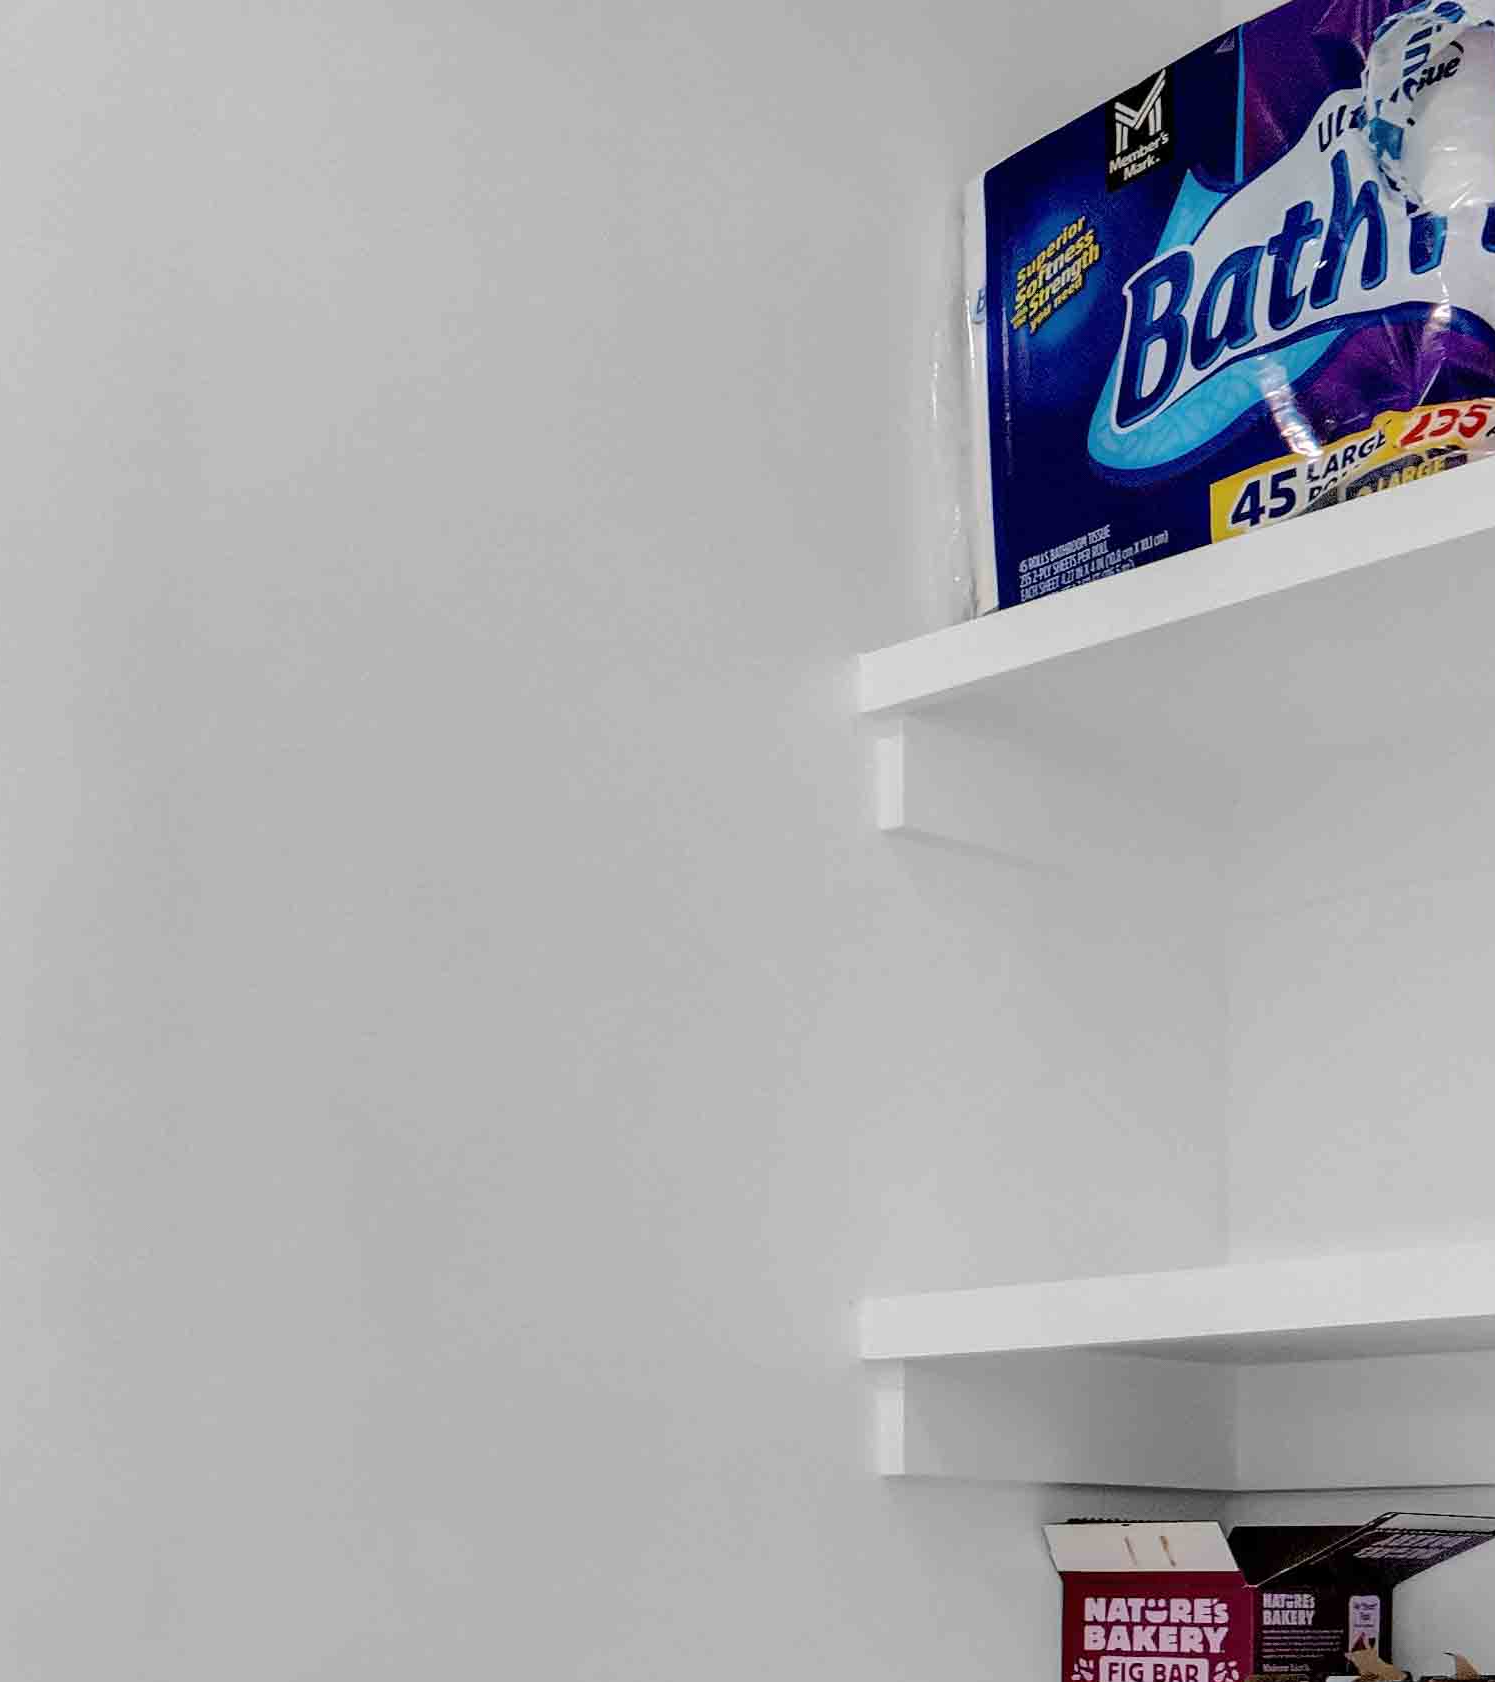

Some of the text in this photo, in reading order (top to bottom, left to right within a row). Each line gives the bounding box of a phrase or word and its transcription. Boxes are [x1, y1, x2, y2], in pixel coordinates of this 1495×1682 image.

[1109, 130, 1169, 174] Member's
[1015, 229, 1094, 311] Softness
[1016, 215, 1086, 284] Superior
[1029, 243, 1101, 318] Strength
[1117, 150, 1388, 426] Bath
[1230, 467, 1299, 528] 45
[1084, 1625, 1230, 1653] BAKERY
[1262, 1610, 1314, 1626] BAKERY
